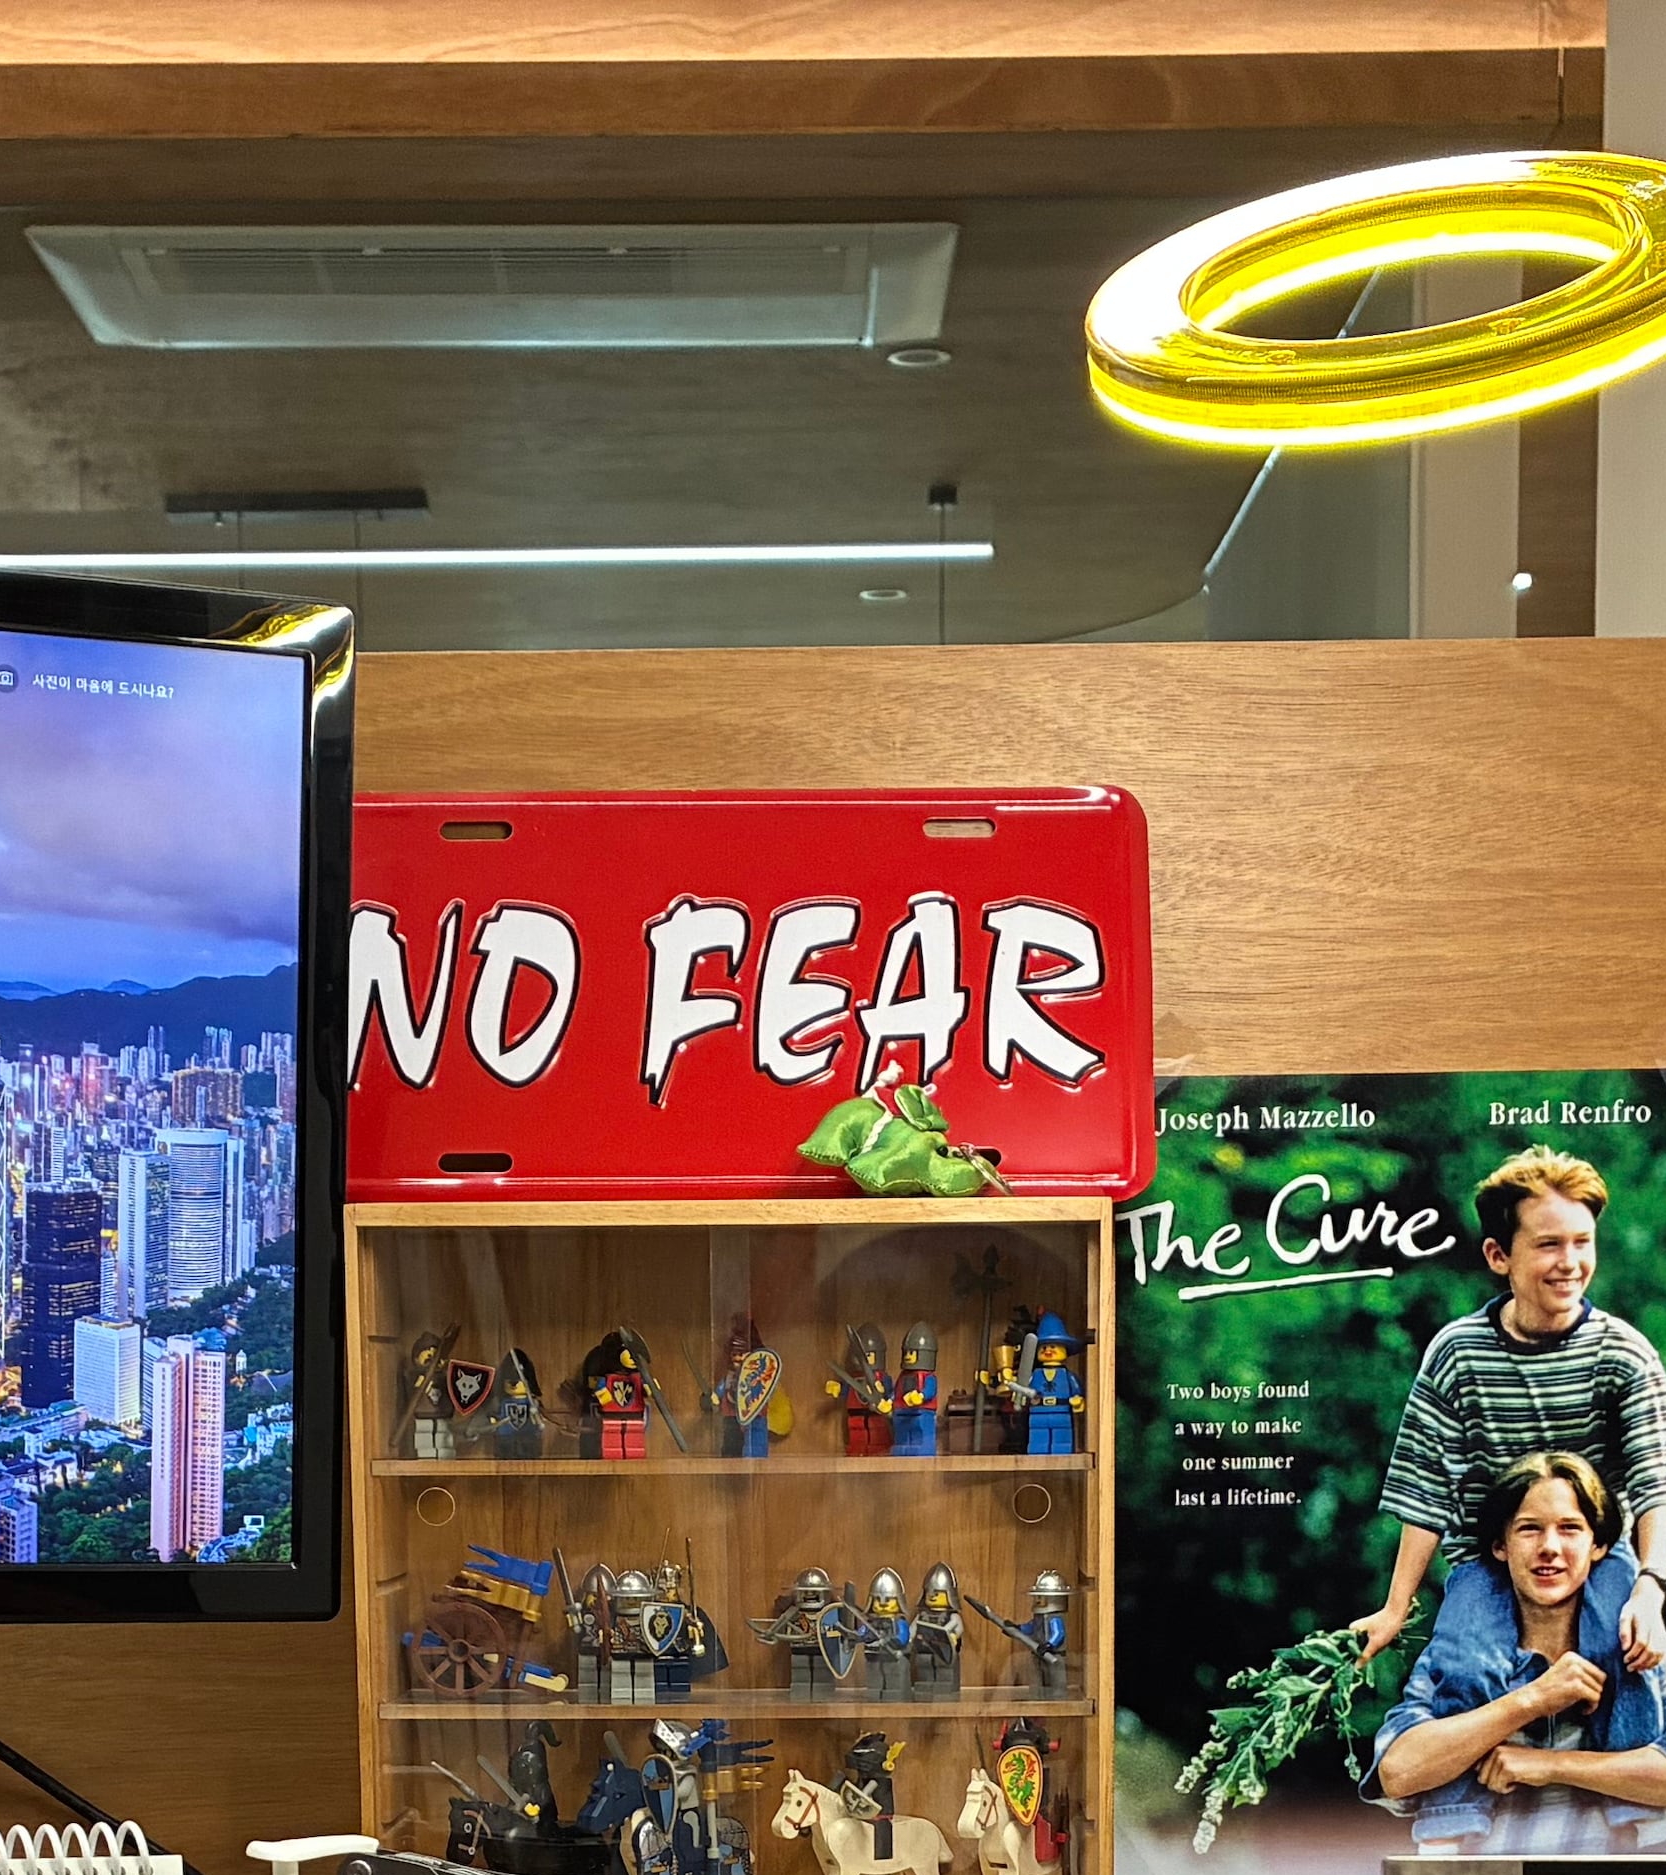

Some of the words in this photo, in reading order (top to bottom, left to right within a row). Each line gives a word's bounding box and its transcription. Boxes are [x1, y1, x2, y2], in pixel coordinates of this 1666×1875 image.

[32, 673, 71, 691] 사진이
[76, 677, 114, 695] 마음에
[118, 681, 174, 699] 드시나요?
[348, 897, 582, 1090] NO
[640, 891, 1108, 1108] FEAR
[1155, 1104, 1250, 1137] Joseph
[1259, 1102, 1375, 1130] Mazzello
[1489, 1101, 1550, 1127] Brad
[1559, 1100, 1652, 1125] Renfro
[1115, 1200, 1250, 1287] The
[1265, 1174, 1456, 1265] Cure
[1167, 1383, 1204, 1400] Two
[1209, 1382, 1251, 1403] boys
[1258, 1380, 1310, 1399] found
[1174, 1423, 1184, 1436] a
[1190, 1422, 1226, 1440] way
[1231, 1418, 1249, 1435] to
[1255, 1417, 1302, 1435] make
[1182, 1457, 1216, 1471] one
[1221, 1454, 1294, 1471] summer
[1174, 1489, 1207, 1506] last
[1211, 1493, 1221, 1506] a
[1227, 1488, 1302, 1506] lifetime.
